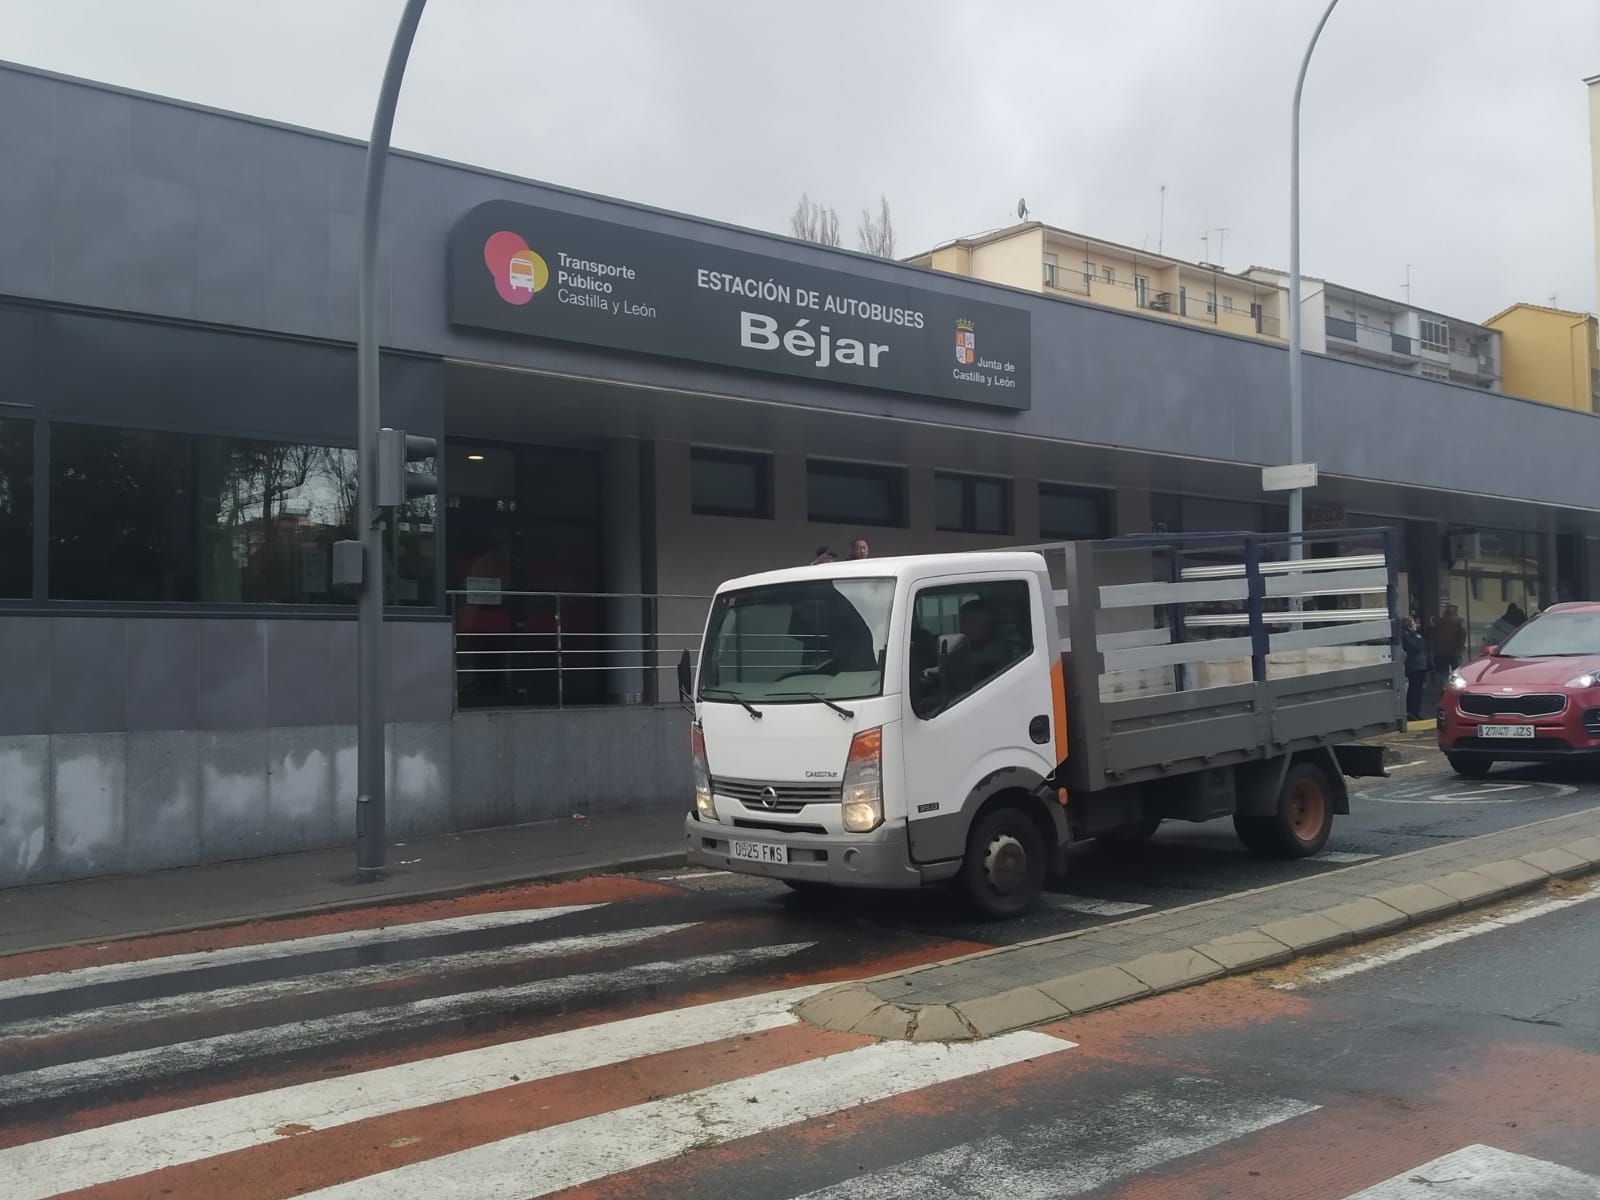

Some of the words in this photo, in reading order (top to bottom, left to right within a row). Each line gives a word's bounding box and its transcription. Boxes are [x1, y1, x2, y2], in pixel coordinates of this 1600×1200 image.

[557, 252, 636, 280] Transporte
[558, 271, 612, 293] Público
[557, 288, 608, 310] Castilla
[612, 301, 620, 314] y
[624, 300, 656, 318] León
[697, 268, 790, 304] ESTACIÓN
[796, 289, 819, 310] DE
[824, 295, 924, 328] AUTOBUSES
[740, 311, 889, 368] Béjar
[953, 368, 985, 384] Castilla
[987, 376, 993, 387] y
[994, 374, 1016, 388] León
[977, 356, 1002, 370] Junta
[1004, 361, 1015, 372] de
